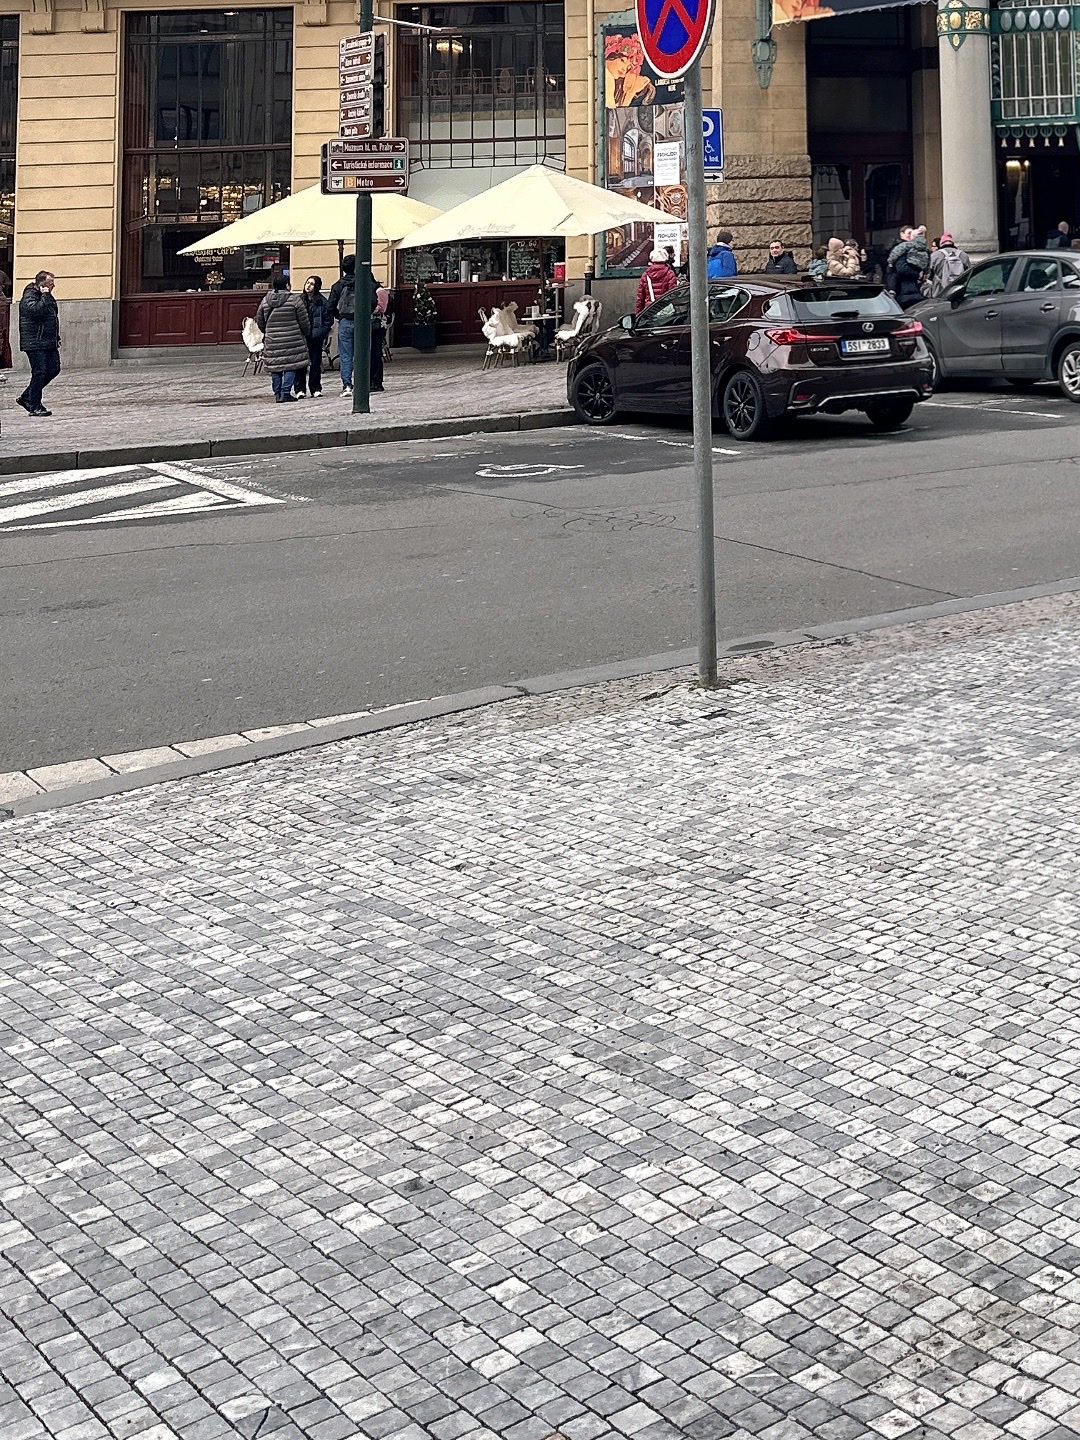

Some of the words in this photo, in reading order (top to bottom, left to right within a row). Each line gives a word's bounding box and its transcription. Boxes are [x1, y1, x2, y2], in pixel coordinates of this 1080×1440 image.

[344, 143, 364, 151] Muzeum
[356, 177, 374, 187] Metro
[847, 340, 862, 351] 5SI
[867, 339, 887, 350] 2833
